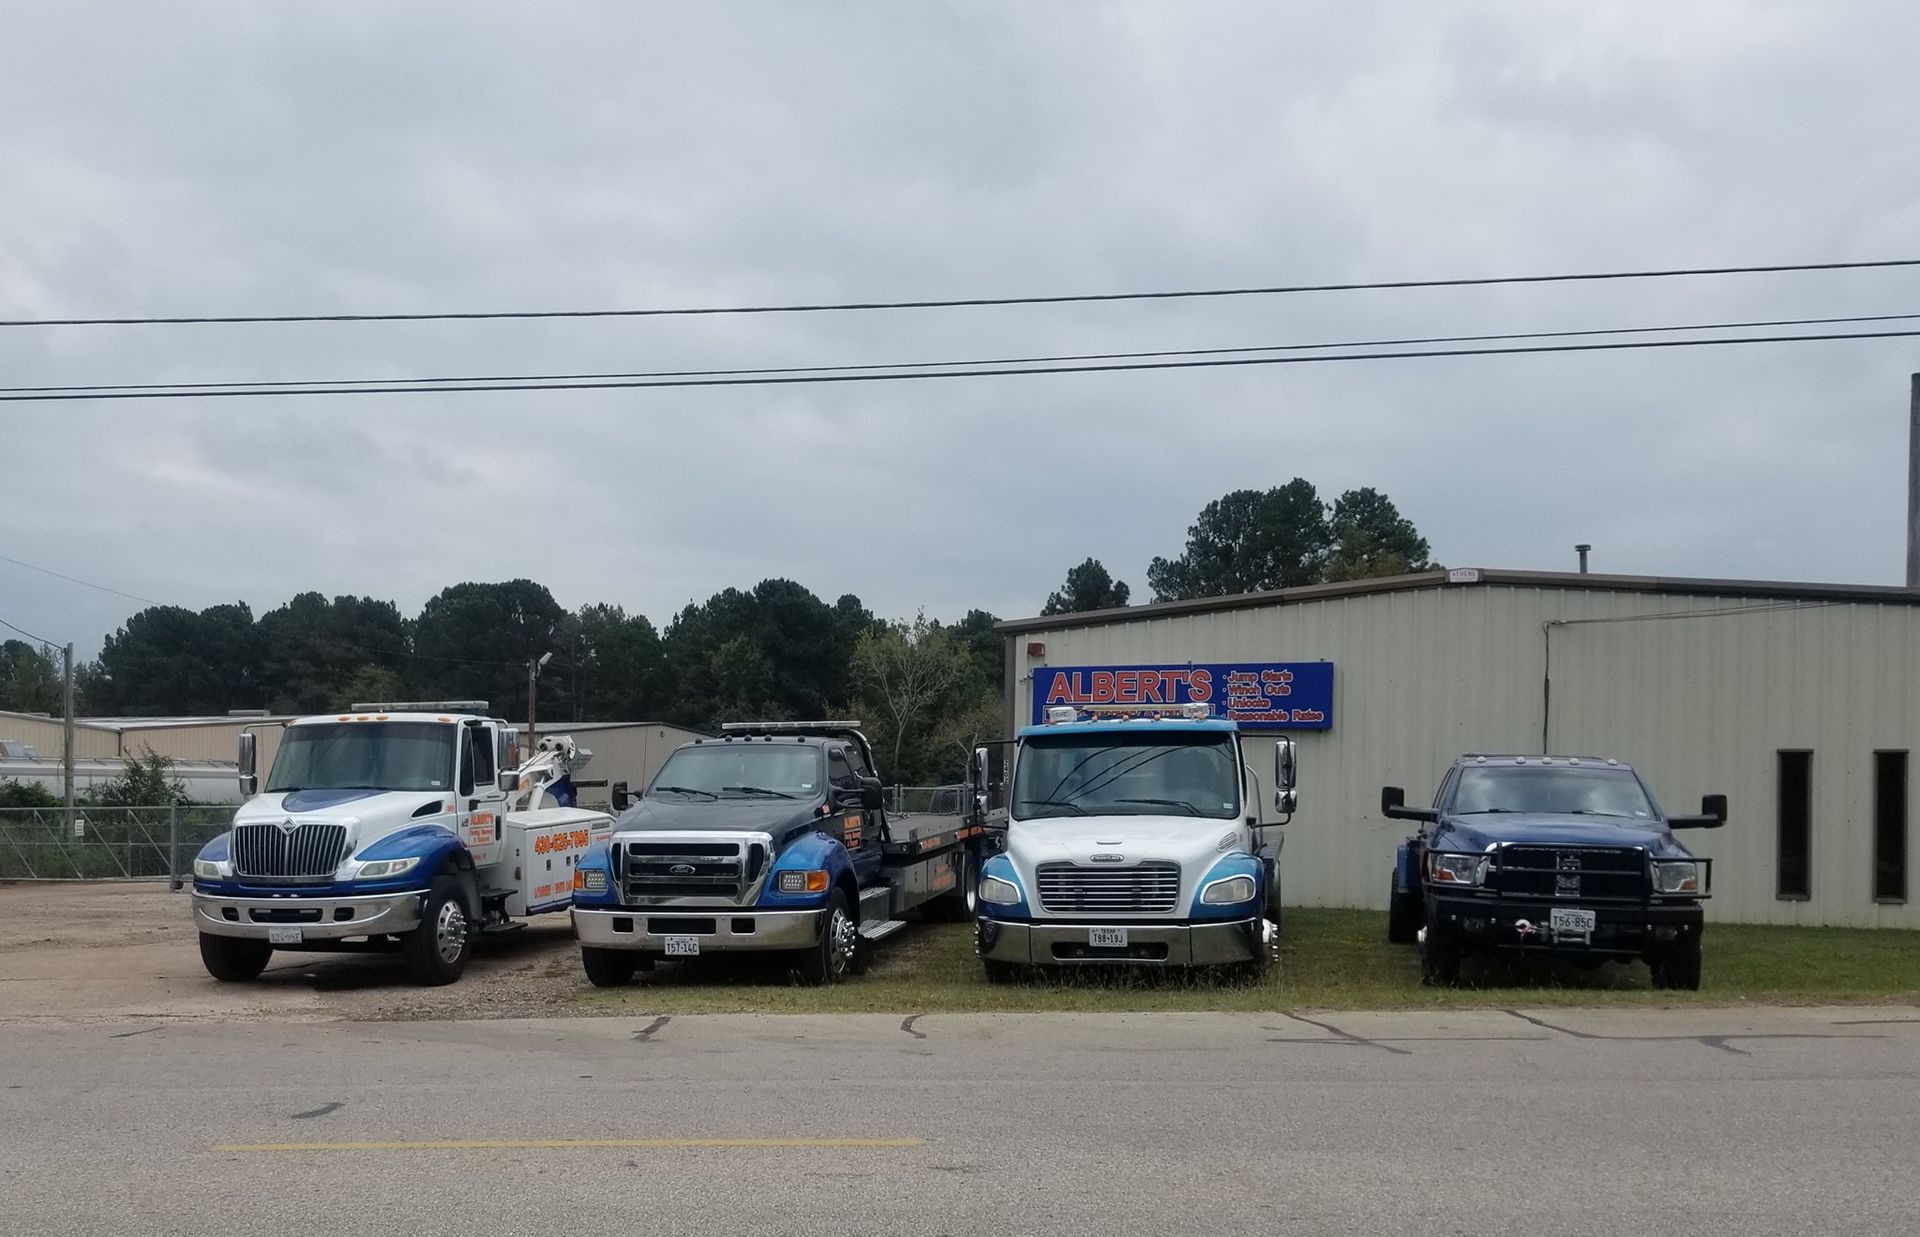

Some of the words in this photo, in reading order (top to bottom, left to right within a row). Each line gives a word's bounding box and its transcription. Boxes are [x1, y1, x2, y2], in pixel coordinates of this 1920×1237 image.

[1227, 670, 1258, 685] Jump
[1261, 669, 1293, 682] Starts
[1047, 669, 1212, 703] ALBERT'S
[1227, 683, 1261, 696] Winch
[1227, 697, 1271, 709] Unlocks
[1227, 709, 1289, 722] Reasonable
[1292, 708, 1324, 722] Rates
